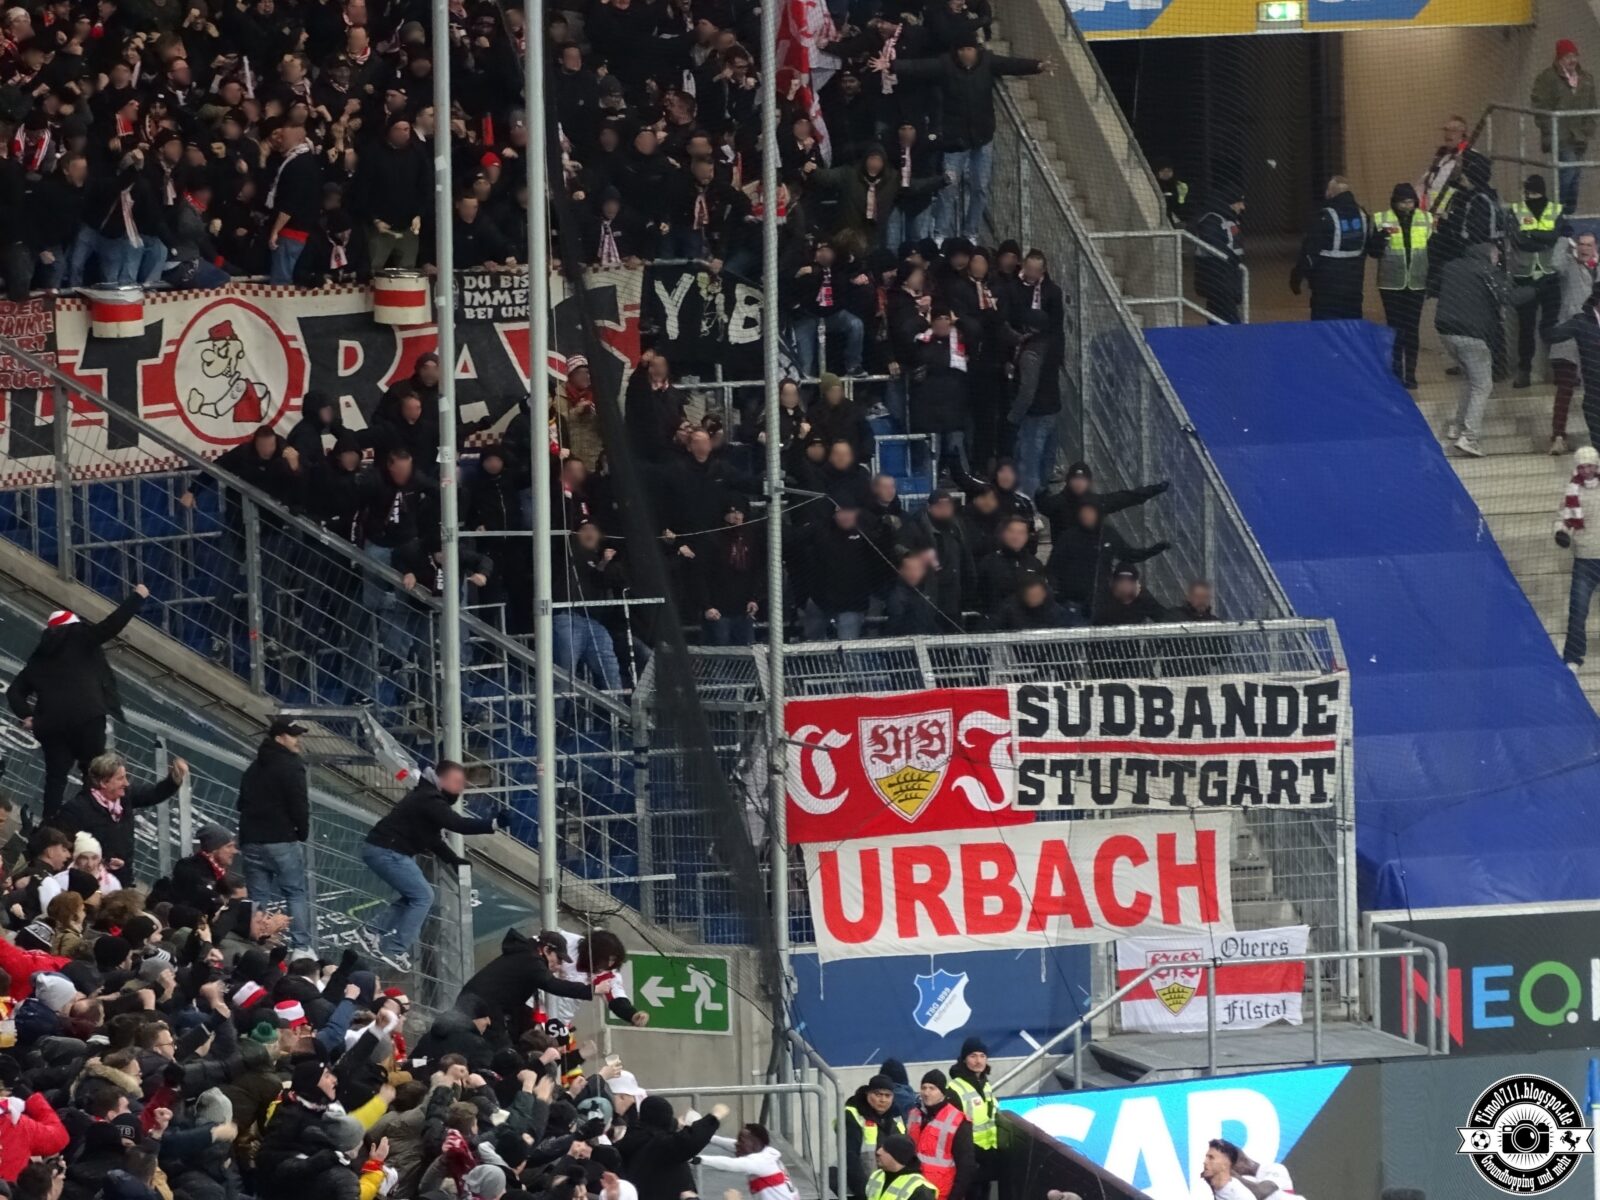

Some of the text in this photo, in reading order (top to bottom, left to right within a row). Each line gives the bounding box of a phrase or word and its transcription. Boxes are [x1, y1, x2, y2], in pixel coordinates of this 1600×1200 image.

[463, 274, 530, 289] DU BIS
[463, 290, 530, 306] IMME
[463, 307, 494, 319] BEI
[1016, 679, 1341, 738] SÜDBANDE
[1017, 756, 1337, 807] STUTTGART
[818, 830, 1221, 945] URBACH
[1221, 937, 1290, 958] Oberes
[1222, 1000, 1287, 1025] Filstal
